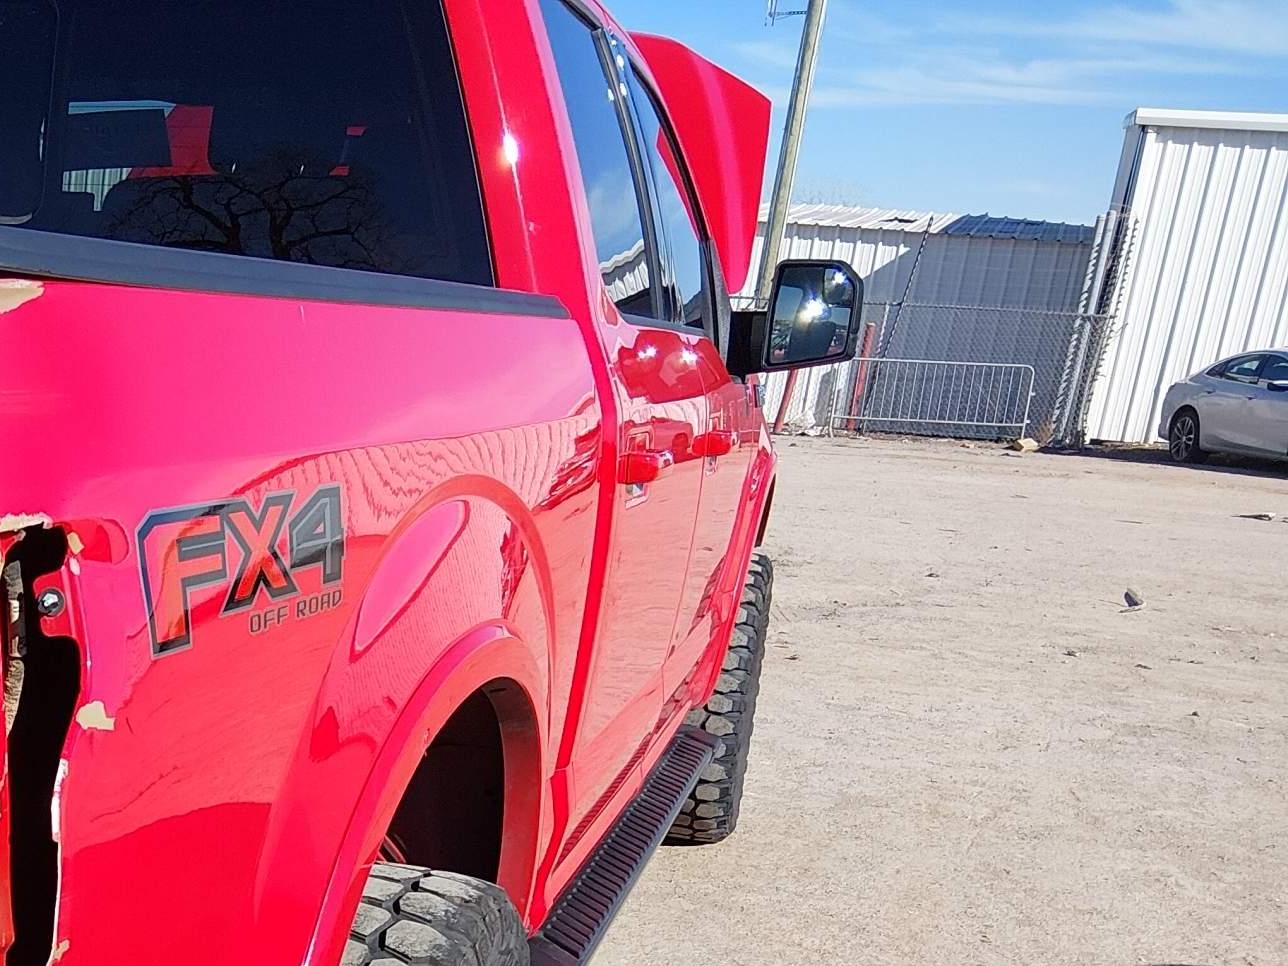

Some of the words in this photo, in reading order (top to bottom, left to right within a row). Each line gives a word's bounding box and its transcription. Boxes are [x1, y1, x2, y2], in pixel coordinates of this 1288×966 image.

[135, 483, 345, 660] FX4
[249, 605, 289, 633] OFF
[296, 590, 342, 619] ROAD
